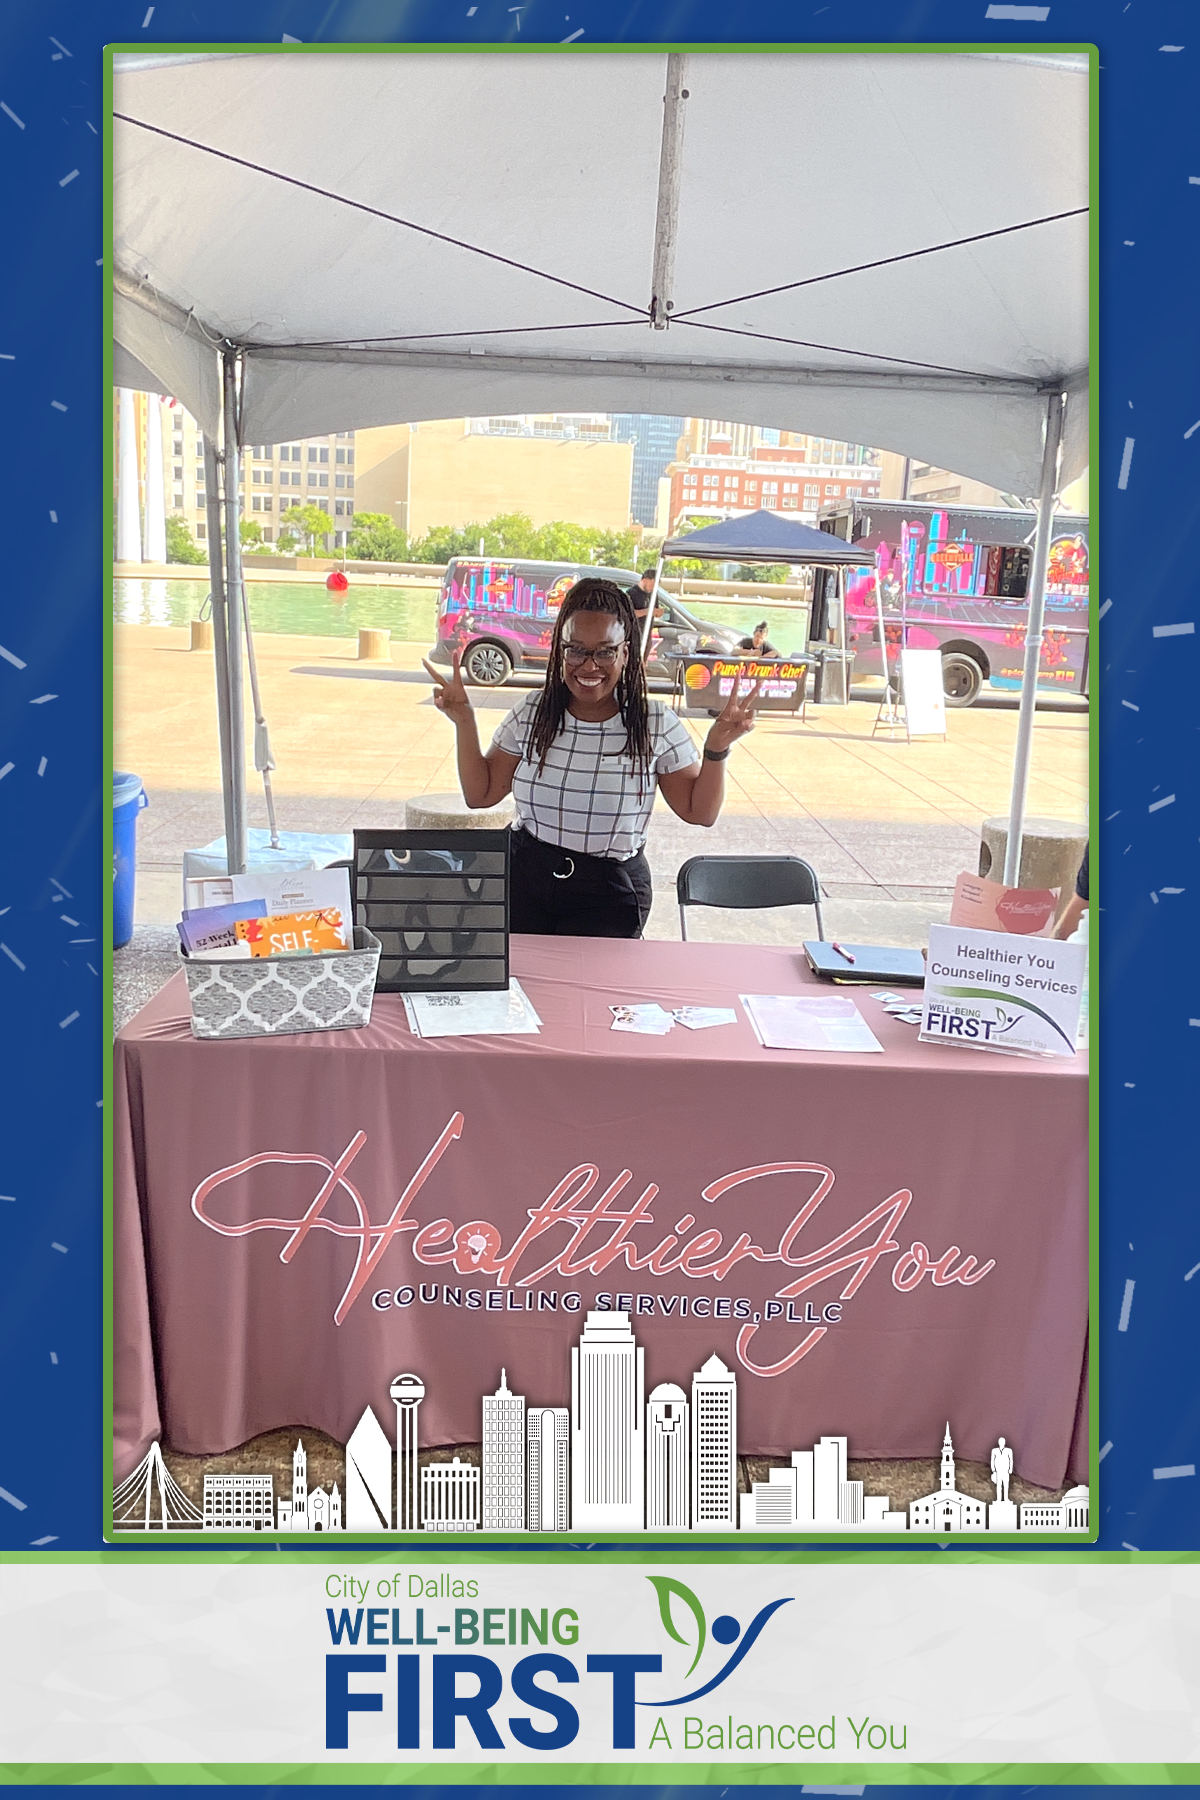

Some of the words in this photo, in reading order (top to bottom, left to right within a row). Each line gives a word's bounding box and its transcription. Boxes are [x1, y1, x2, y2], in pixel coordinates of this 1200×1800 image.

[712, 660, 746, 677] Punch
[747, 662, 779, 678] Drunk
[780, 663, 807, 679] Chef
[719, 677, 757, 698] MAL
[271, 899, 289, 907] Daily
[289, 898, 314, 906] Planner
[957, 944, 1024, 966] Healthier
[1026, 953, 1056, 970] You
[931, 962, 1011, 988] Counseling
[1014, 974, 1078, 995] Services
[928, 1003, 981, 1018] WELL-BEING
[926, 1012, 997, 1040] FIRST
[999, 1035, 1032, 1047] Balanced
[1033, 1040, 1047, 1049] You
[191, 1110, 769, 1325] Healthier
[703, 1160, 996, 1378] You
[371, 1283, 582, 1312] COUNSELING
